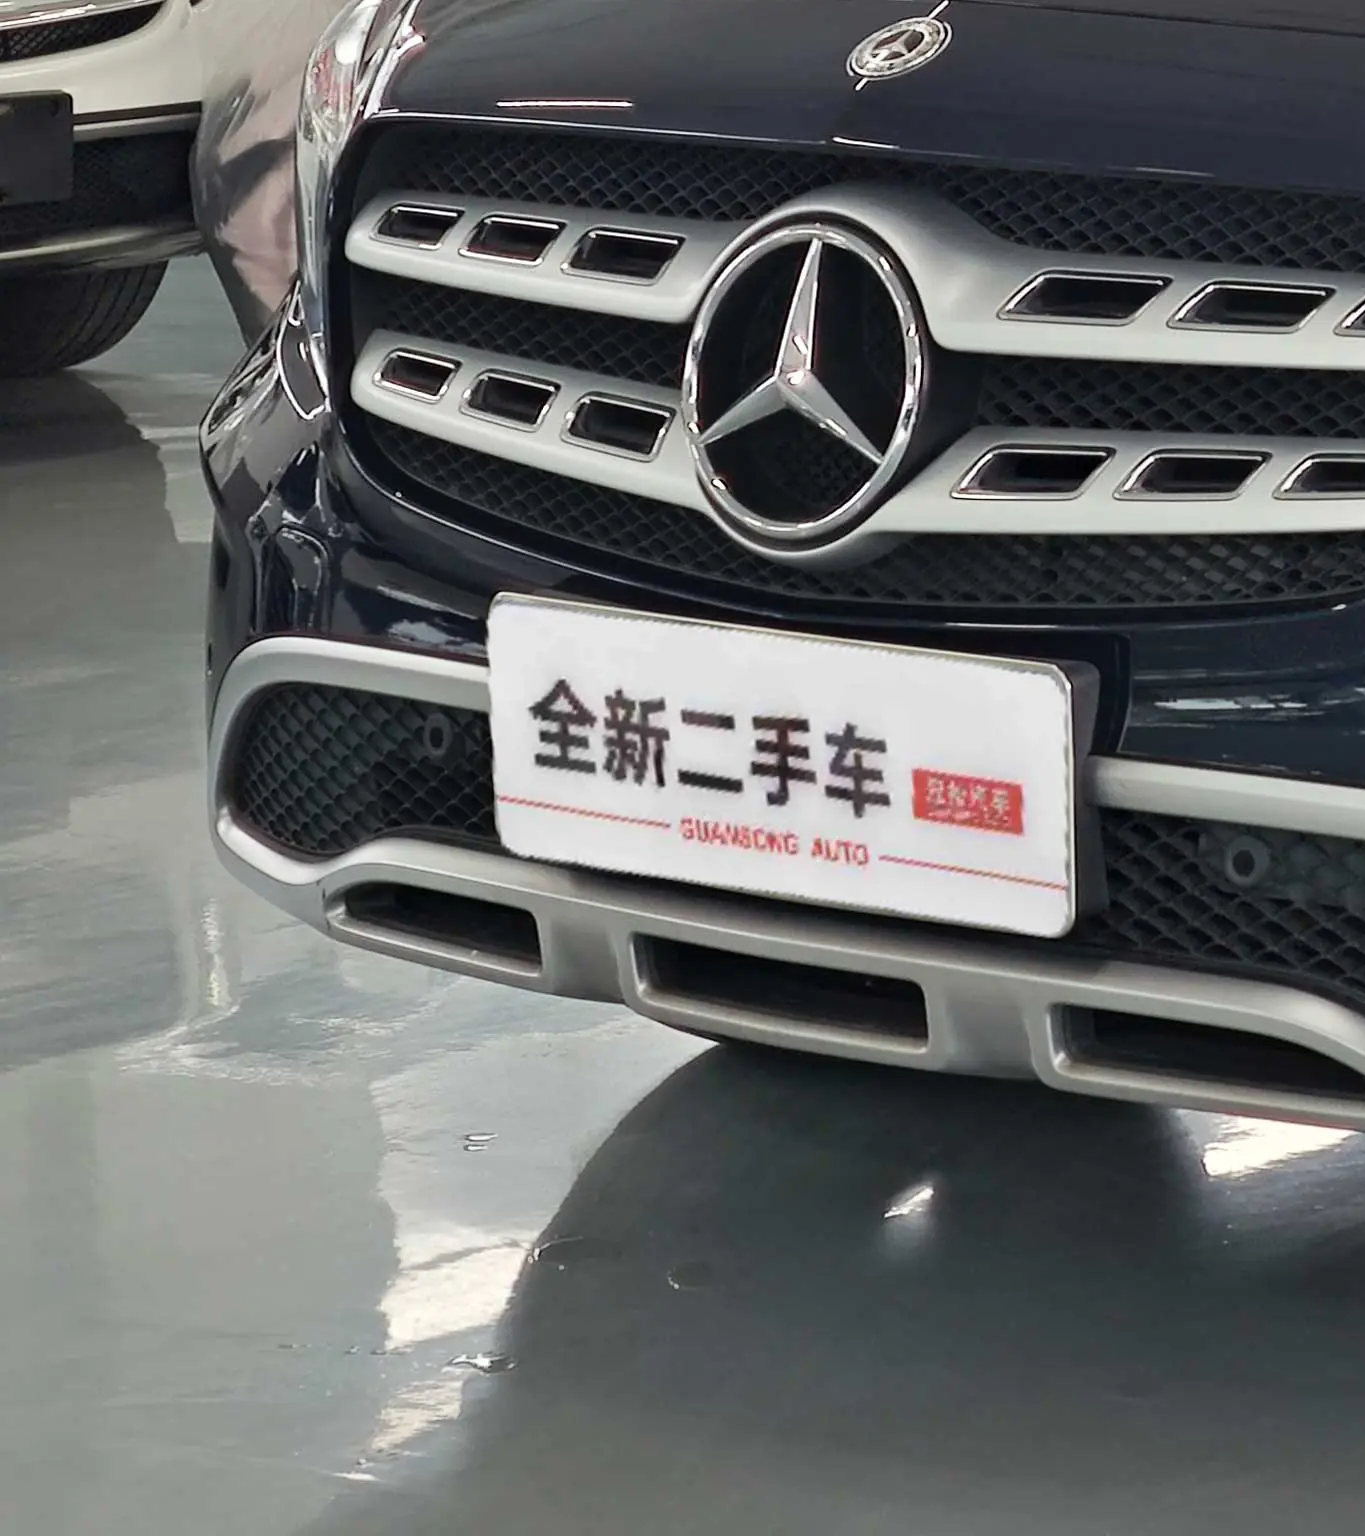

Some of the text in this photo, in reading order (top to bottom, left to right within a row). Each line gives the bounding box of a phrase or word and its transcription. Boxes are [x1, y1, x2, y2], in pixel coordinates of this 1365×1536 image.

[528, 678, 892, 819] 全新二手车
[808, 832, 872, 869] AUTO
